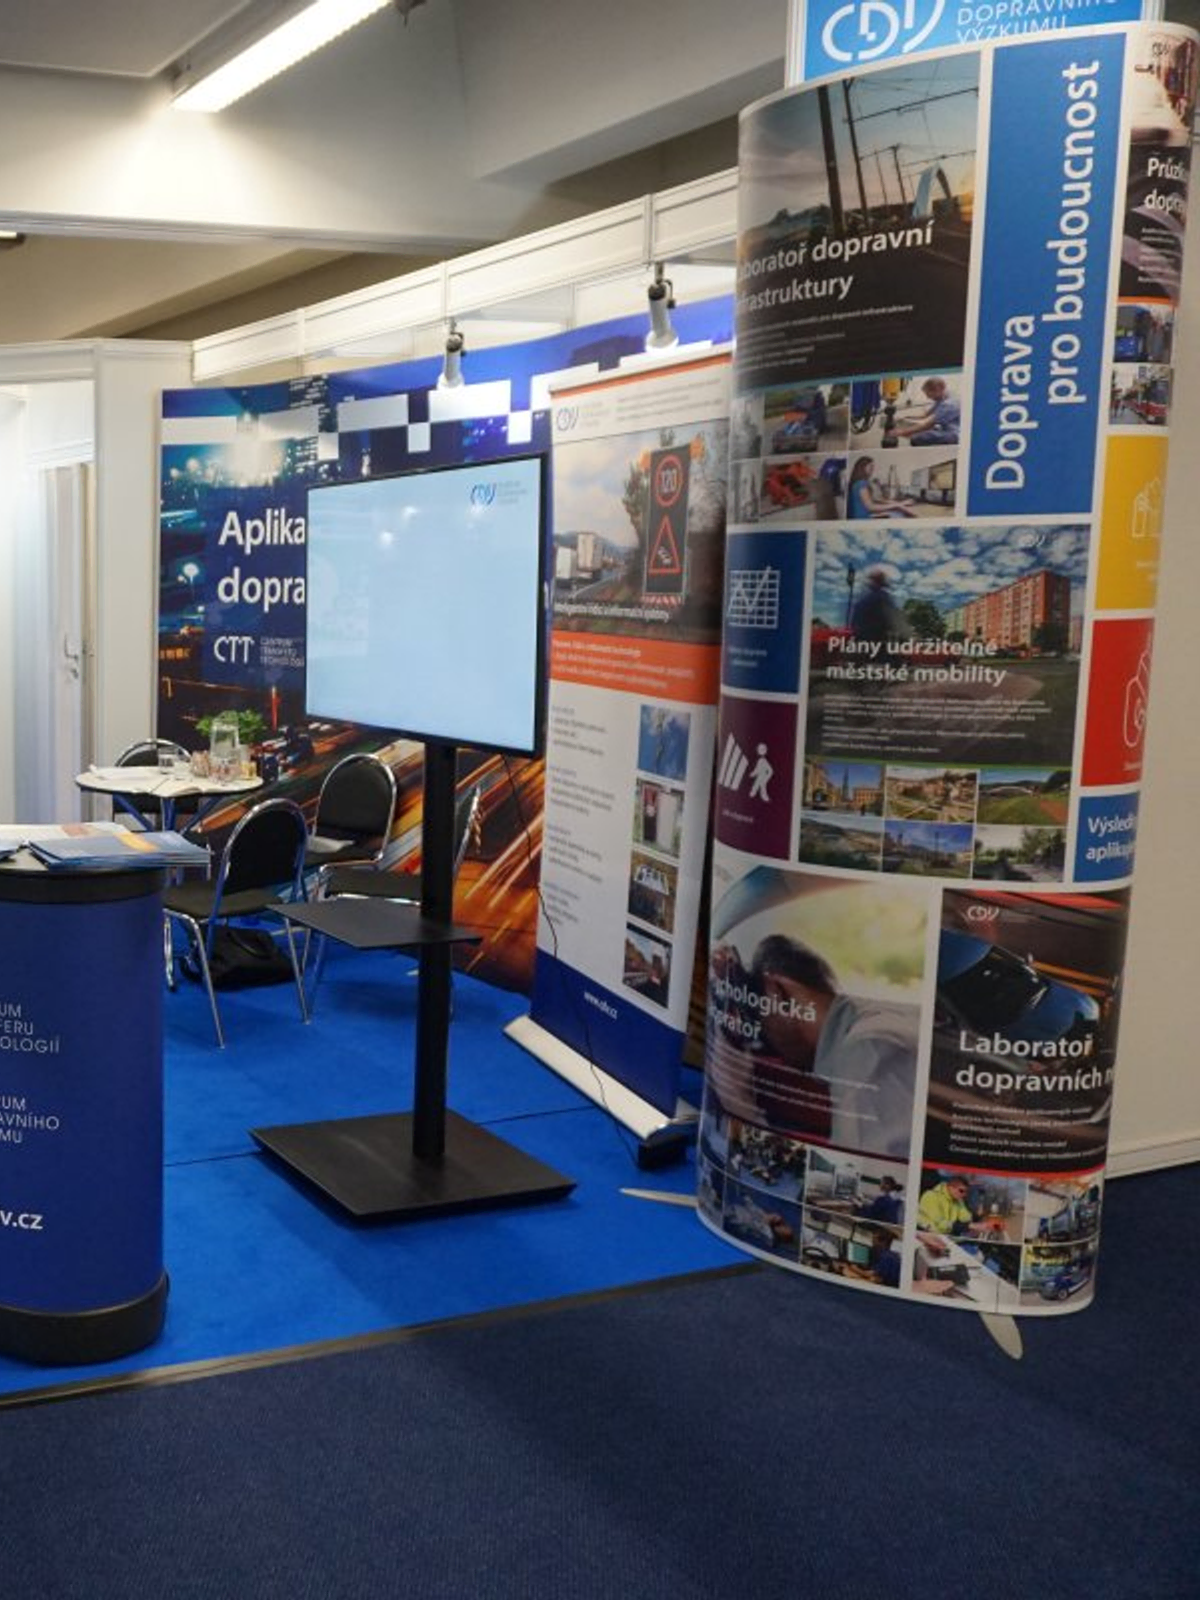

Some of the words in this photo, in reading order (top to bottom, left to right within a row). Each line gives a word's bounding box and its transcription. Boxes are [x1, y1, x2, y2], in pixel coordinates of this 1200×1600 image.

[1041, 59, 1101, 323] budoucnost
[812, 220, 935, 263] dopravní
[1046, 334, 1088, 406] pro
[984, 314, 1039, 491] Doprava
[218, 507, 305, 555] Aplika
[217, 566, 305, 613] dopra
[214, 636, 255, 664] CTT
[828, 636, 882, 659] Plány
[887, 638, 998, 656] udržitelné
[826, 662, 909, 682] městské
[914, 664, 1007, 687] mobility
[959, 1030, 1093, 1058] Laboratoř
[955, 1063, 1101, 1095] dopravních
